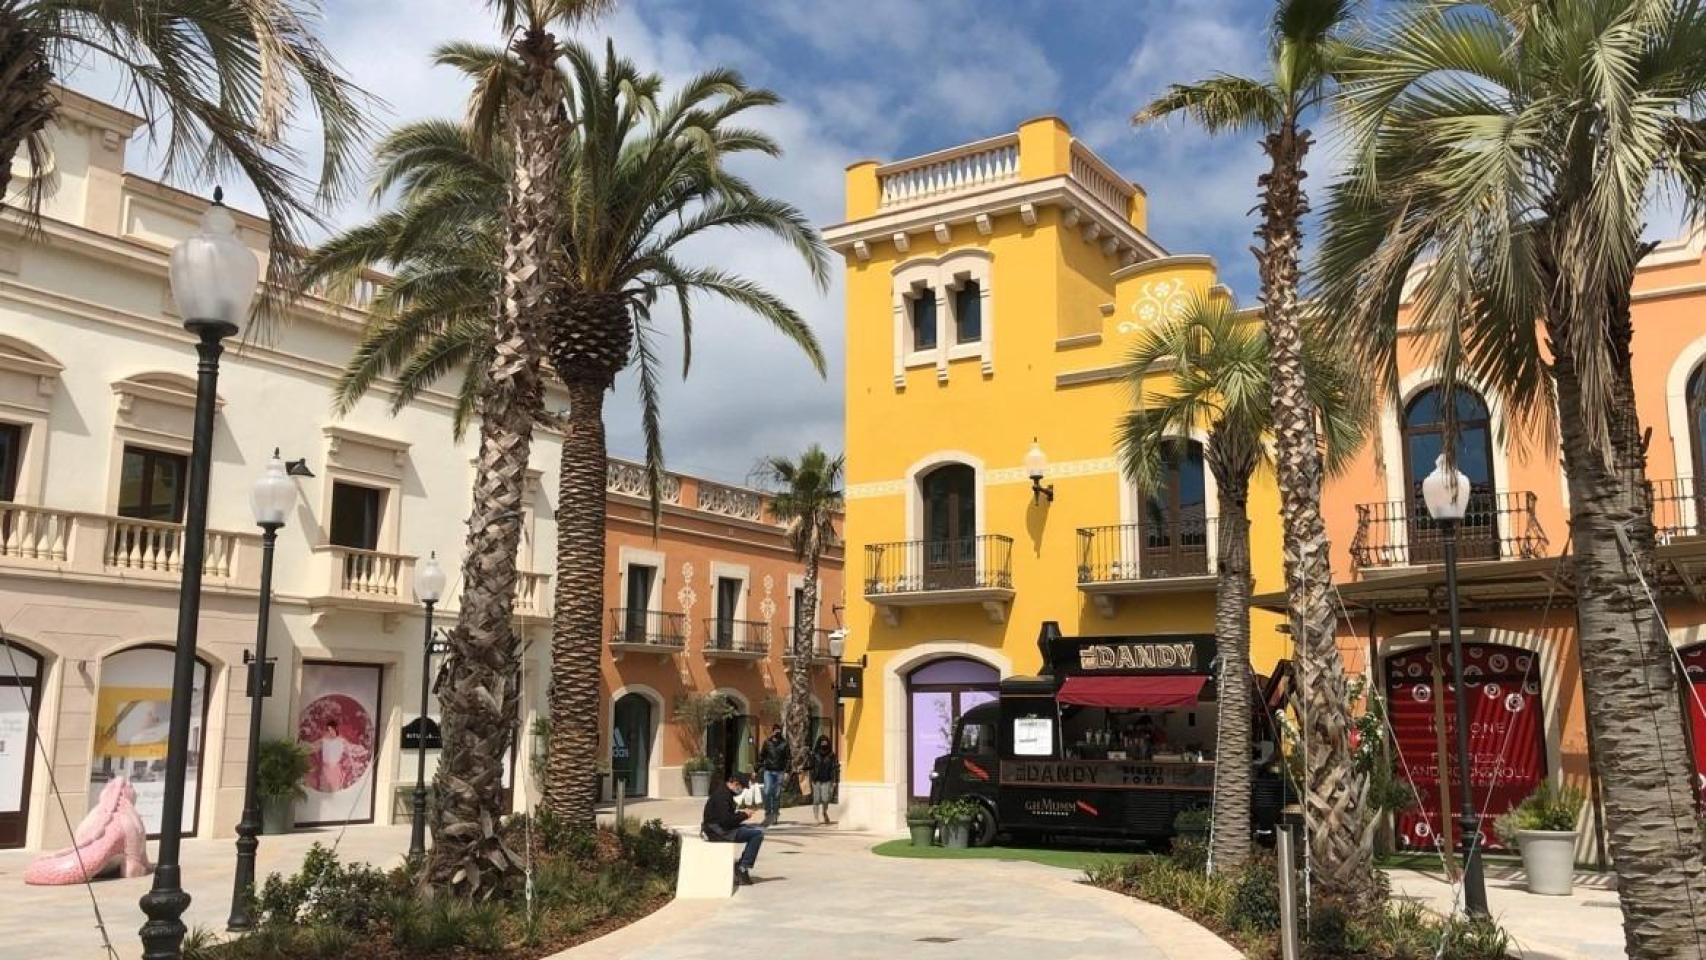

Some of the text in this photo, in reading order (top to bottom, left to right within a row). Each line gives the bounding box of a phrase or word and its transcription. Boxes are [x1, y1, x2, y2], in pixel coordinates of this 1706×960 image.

[1095, 641, 1194, 669] DANDY
[1027, 764, 1100, 784] DANDY
[1122, 776, 1164, 785] FOOD
